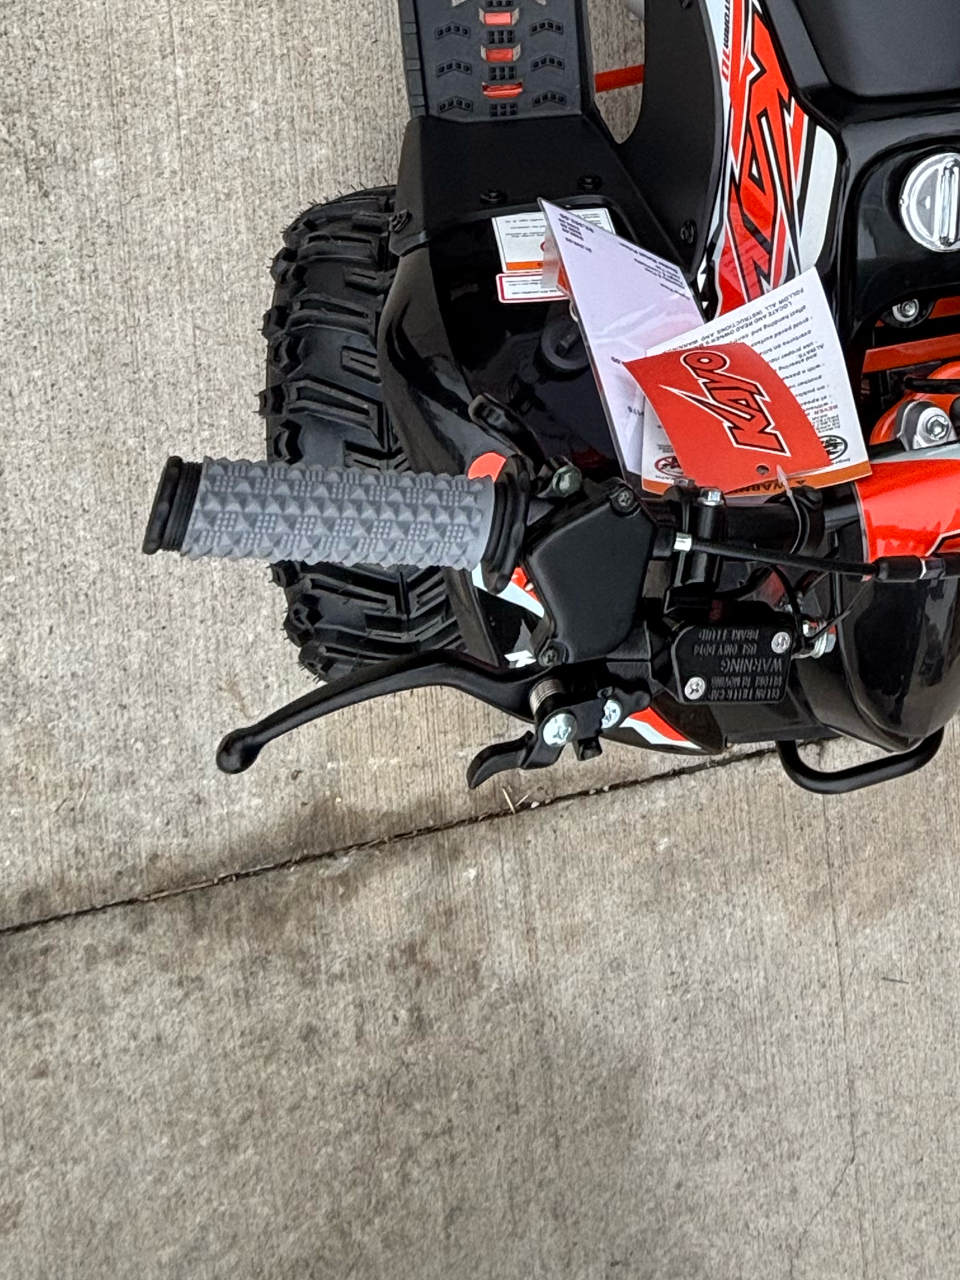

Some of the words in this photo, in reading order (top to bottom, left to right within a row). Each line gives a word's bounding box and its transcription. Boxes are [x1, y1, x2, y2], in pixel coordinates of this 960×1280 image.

[778, 288, 804, 305] FOLLOW
[764, 302, 776, 311] ALL
[767, 301, 792, 317] LOCATE
[716, 310, 762, 334] INSTRUCTIONS
[753, 313, 767, 323] AND
[762, 314, 789, 329] handling
[735, 320, 753, 332] READ
[700, 332, 714, 341] AND
[750, 334, 773, 347] surface
[659, 349, 791, 457] KAYO
[813, 404, 838, 415] NEVER
[720, 657, 782, 673] WARNING
